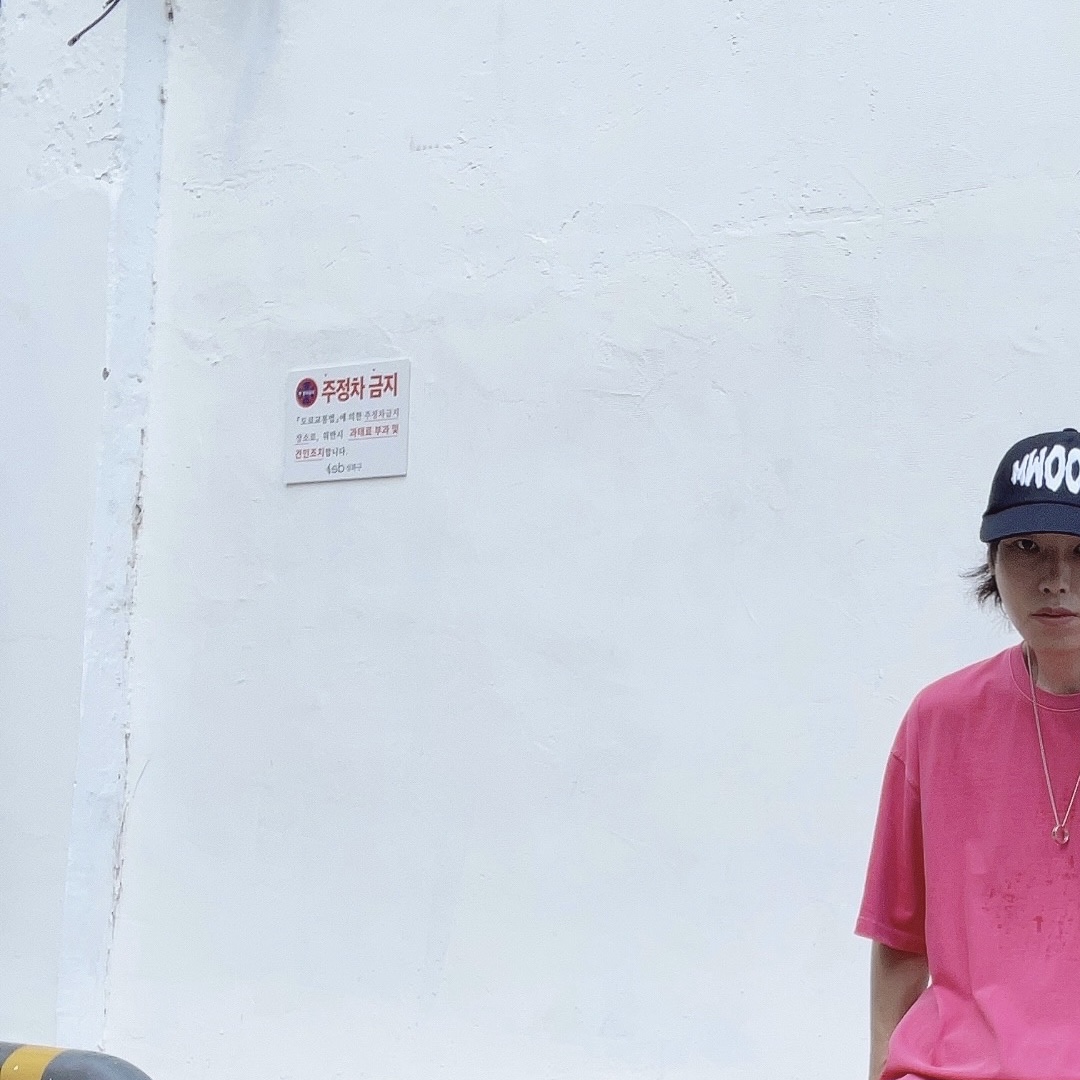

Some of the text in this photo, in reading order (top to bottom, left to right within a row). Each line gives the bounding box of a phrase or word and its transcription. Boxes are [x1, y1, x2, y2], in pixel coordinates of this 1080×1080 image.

[321, 372, 398, 404] 주정차 금지
[349, 426, 372, 439] 과태료
[374, 426, 389, 436] 부과
[392, 424, 399, 434] 및
